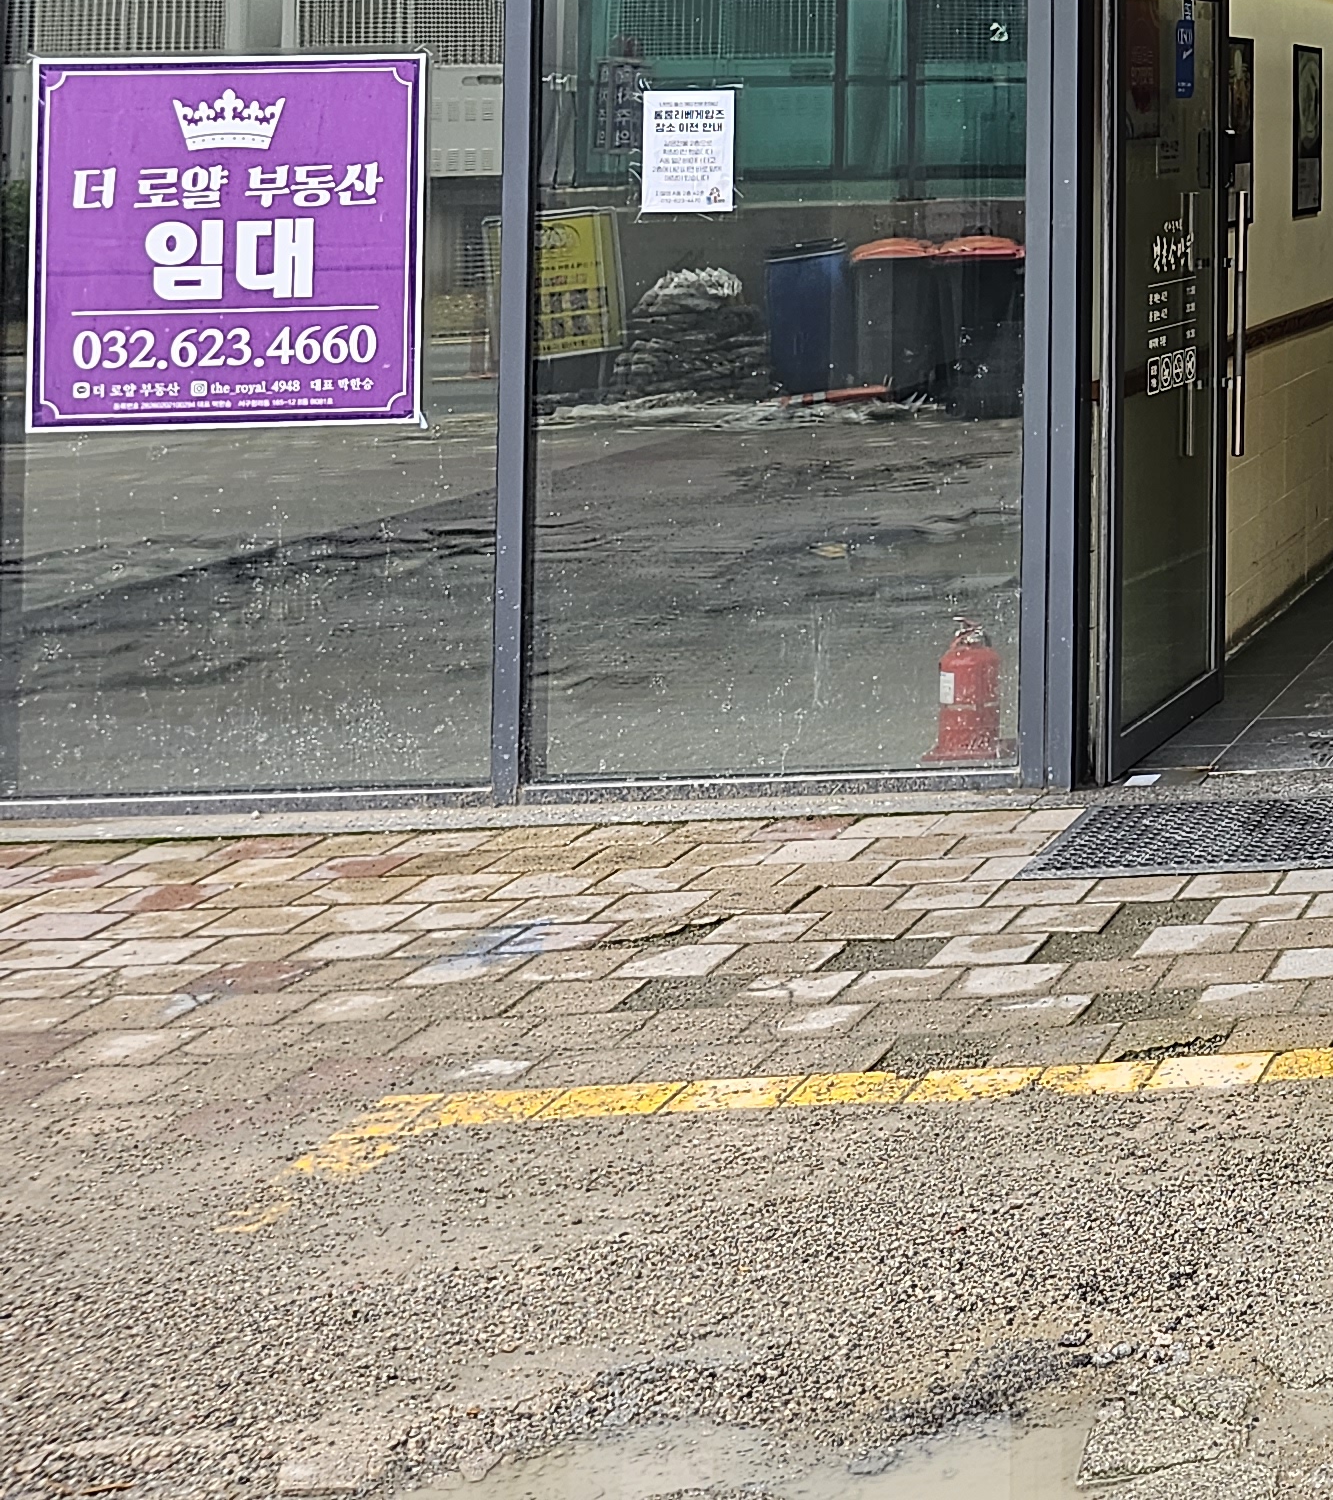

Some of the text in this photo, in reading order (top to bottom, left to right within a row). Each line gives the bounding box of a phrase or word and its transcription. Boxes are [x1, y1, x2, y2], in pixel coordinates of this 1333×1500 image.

[655, 122, 723, 133] 장소 이전 안내
[73, 161, 383, 209] 더 로얄 부동산
[145, 217, 315, 301] 임대
[73, 324, 378, 370] 032.623.4660
[93, 384, 105, 398] 더
[138, 383, 180, 397] 부동산
[210, 379, 300, 396] the_royal_4948
[310, 379, 334, 392] 대표
